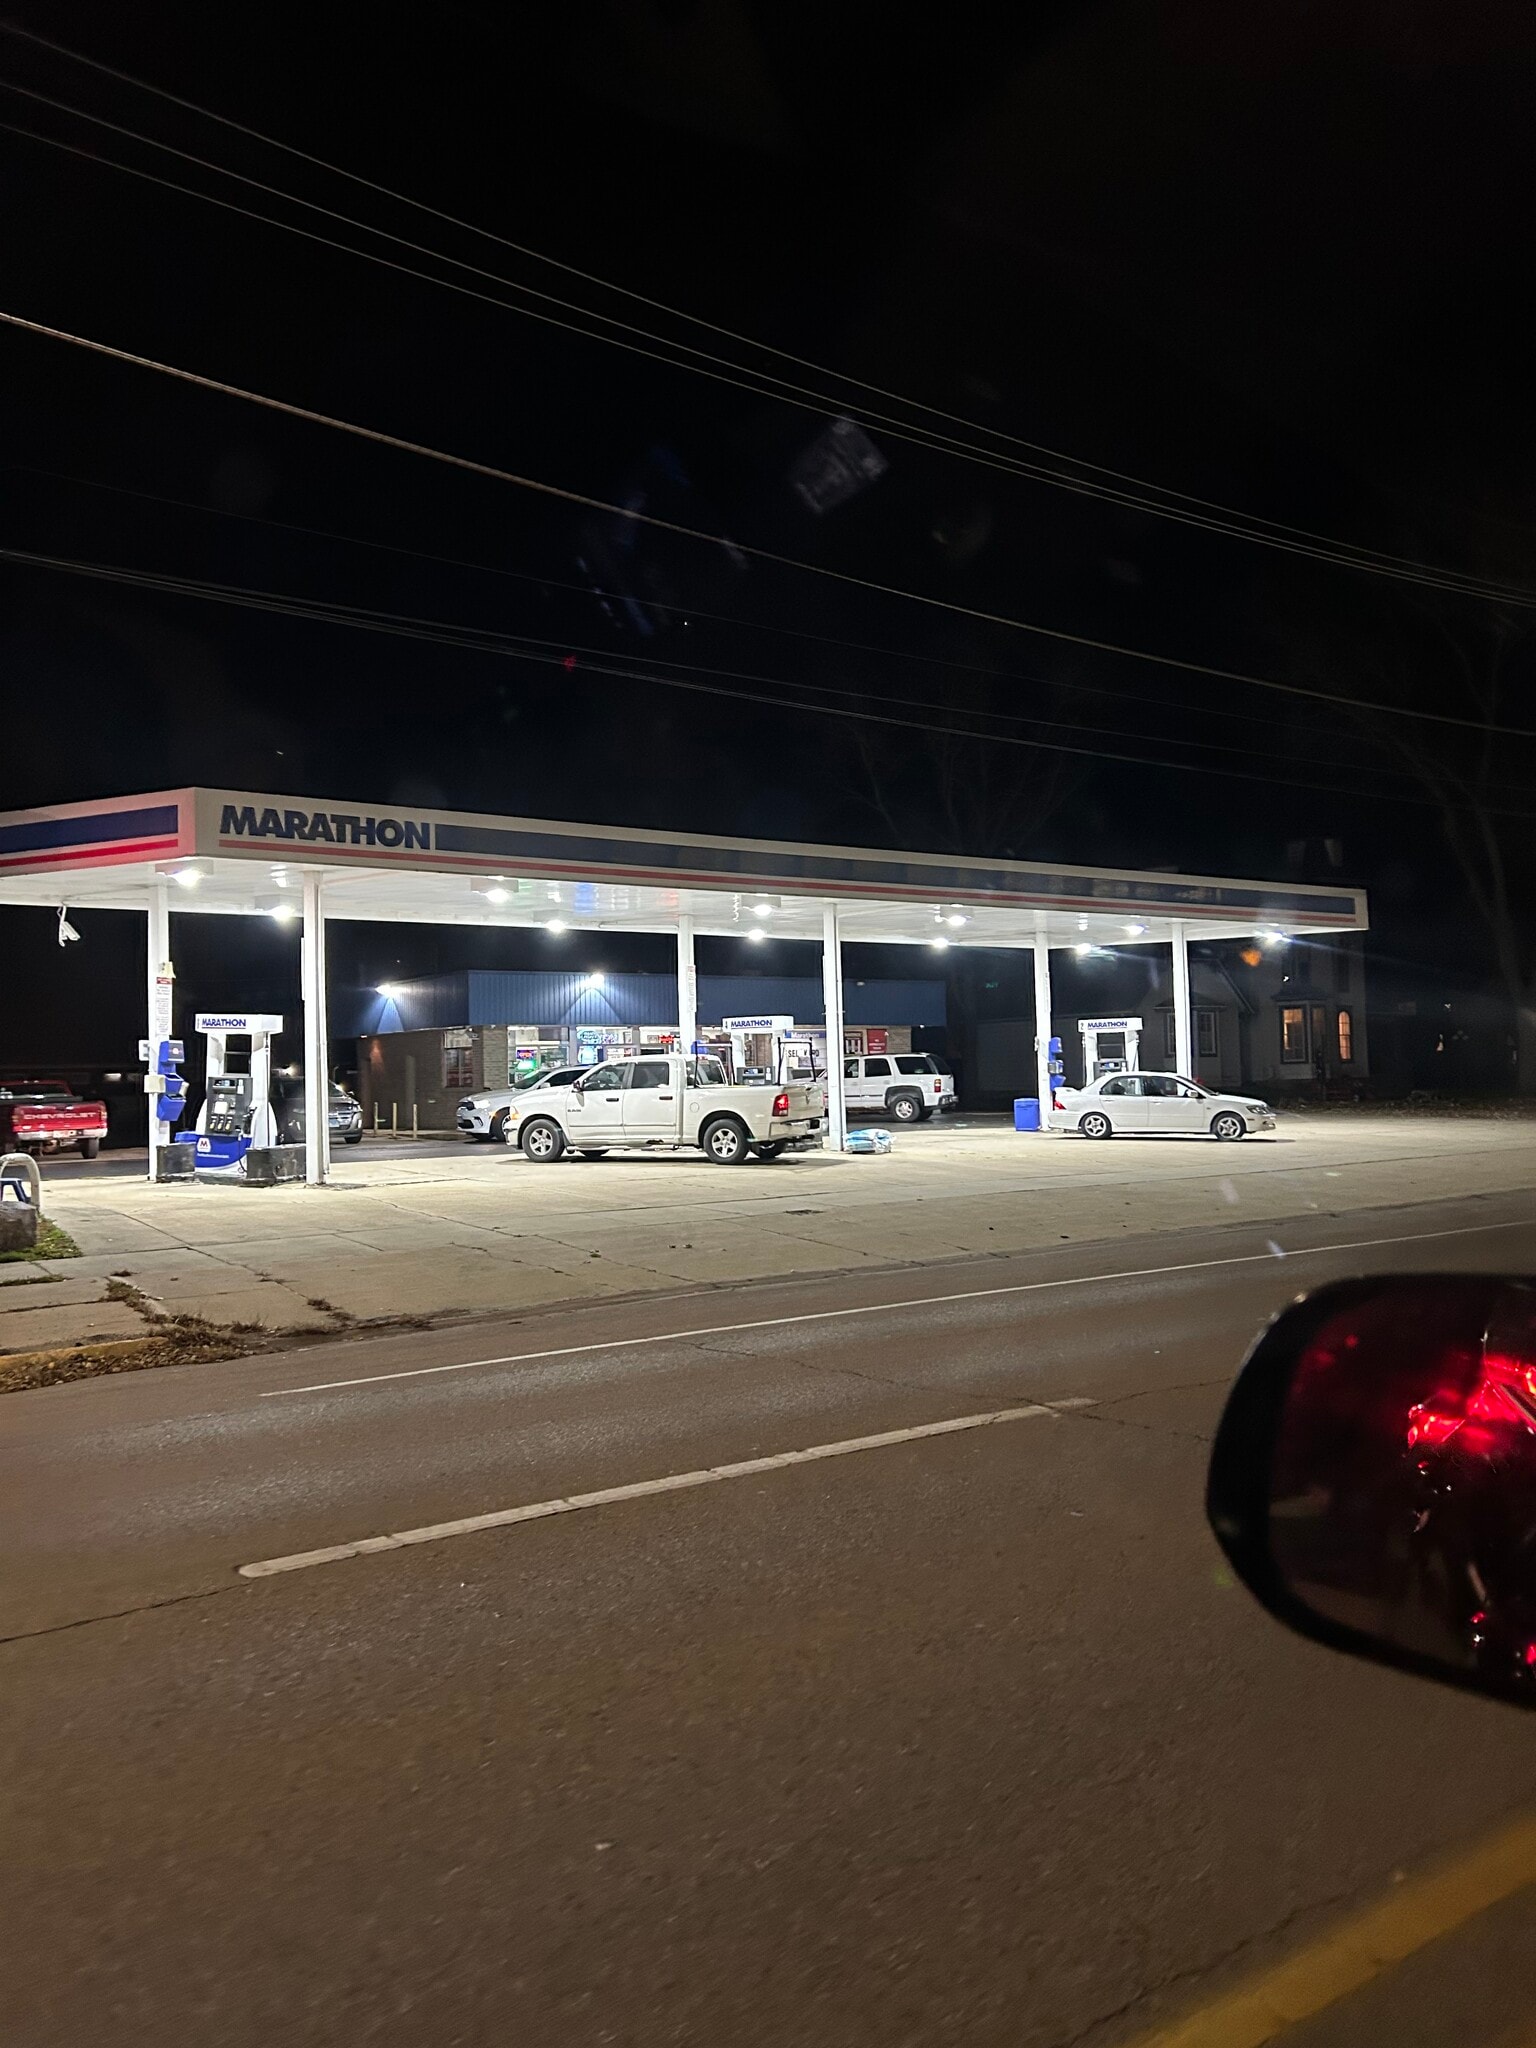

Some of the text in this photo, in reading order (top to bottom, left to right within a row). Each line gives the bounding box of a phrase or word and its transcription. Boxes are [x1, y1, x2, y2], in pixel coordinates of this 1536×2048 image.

[220, 805, 430, 850] MARATHON
[202, 1018, 246, 1027] MARATHON
[23, 1112, 96, 1120] CHEVROLET
